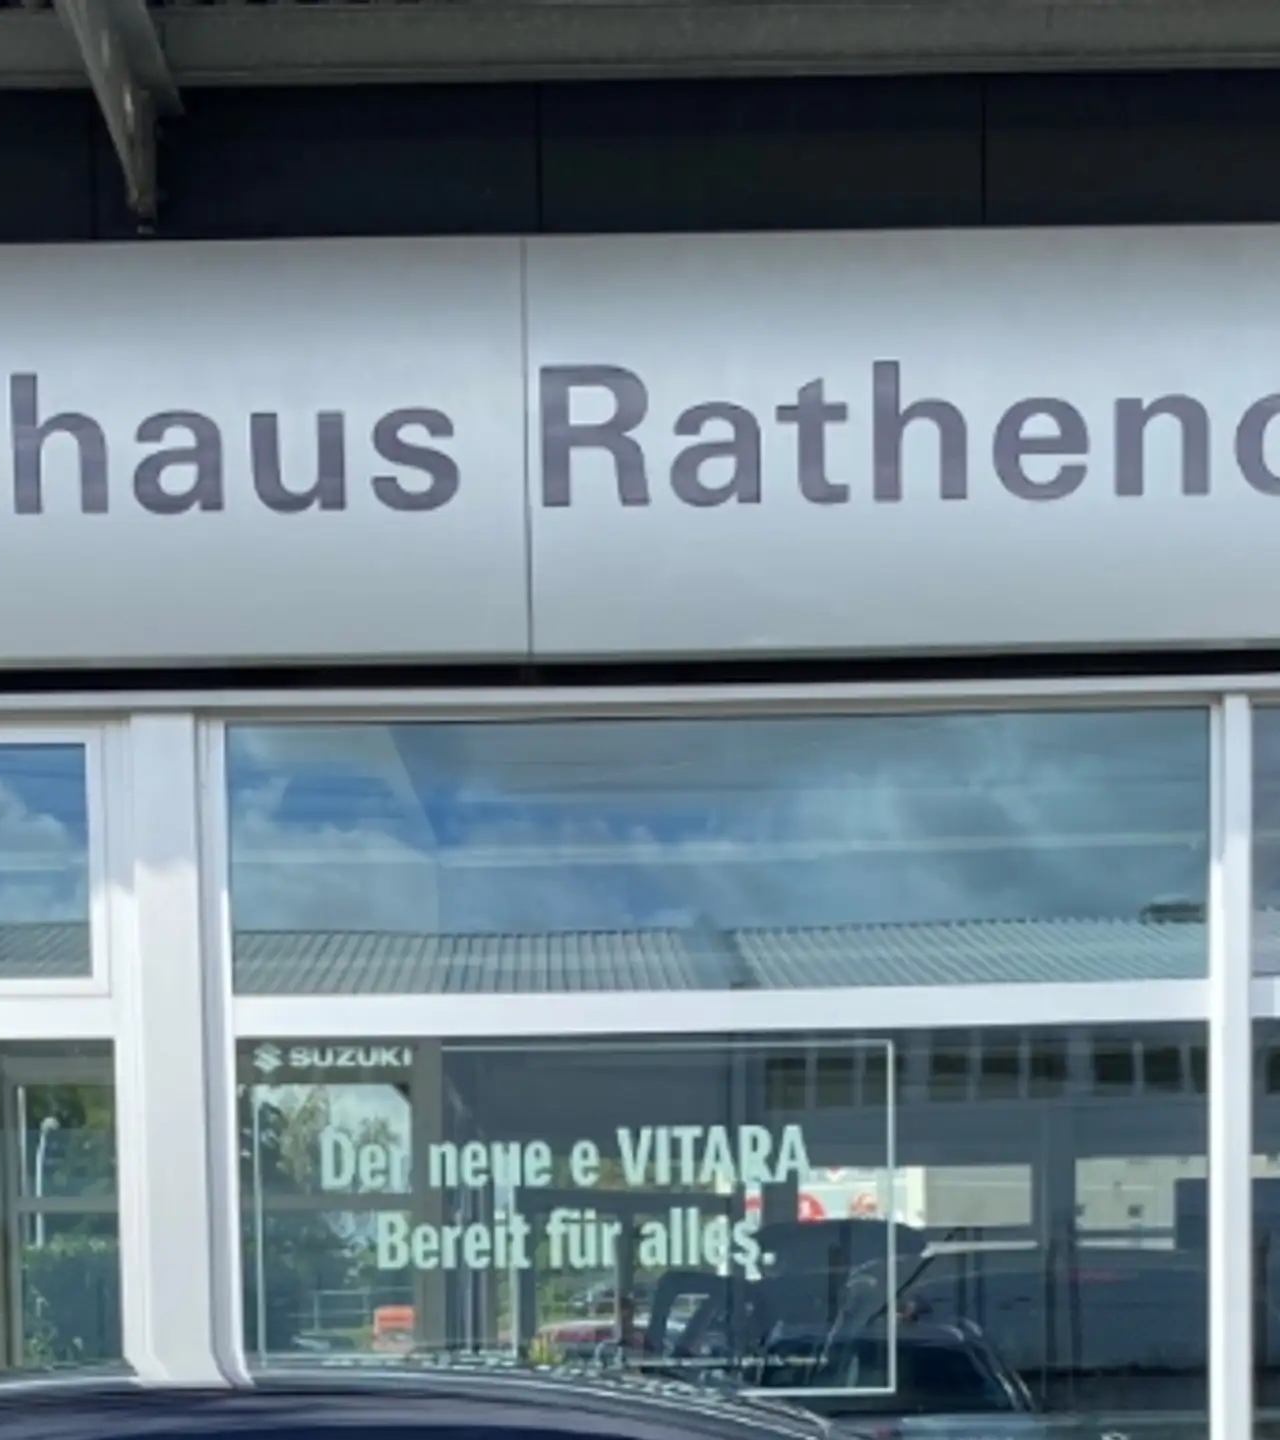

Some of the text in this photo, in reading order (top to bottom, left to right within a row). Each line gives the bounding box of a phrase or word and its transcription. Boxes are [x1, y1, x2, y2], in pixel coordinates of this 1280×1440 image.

[288, 1046, 414, 1069] SUZUKI
[320, 1125, 812, 1193] Der neue e VITARA
[377, 1207, 775, 1270] Bereit für alles.
